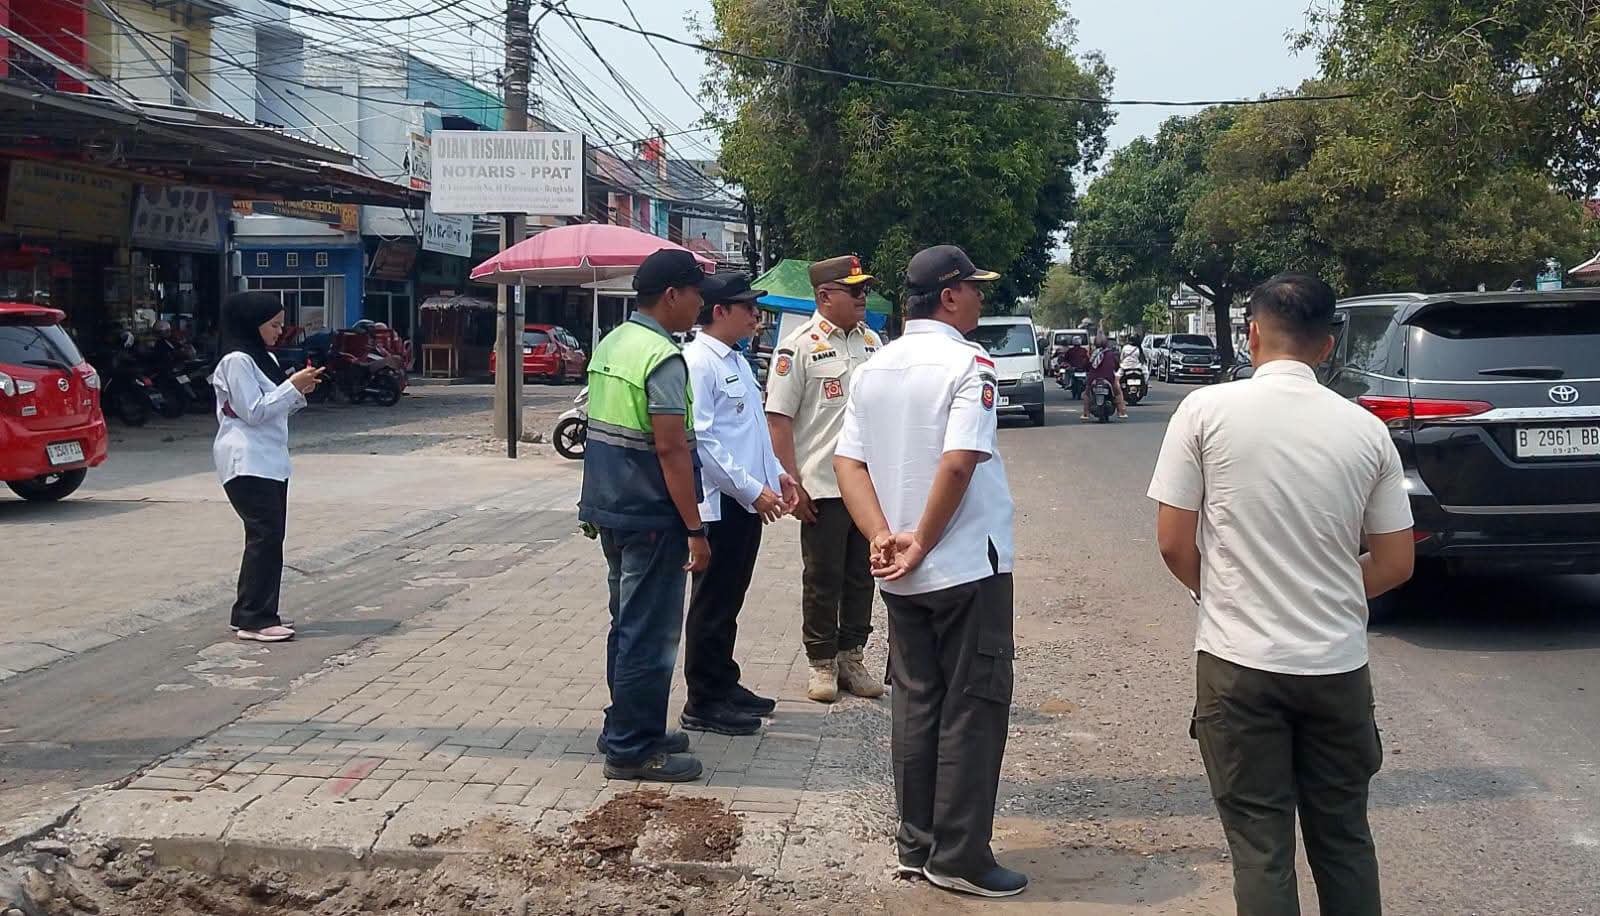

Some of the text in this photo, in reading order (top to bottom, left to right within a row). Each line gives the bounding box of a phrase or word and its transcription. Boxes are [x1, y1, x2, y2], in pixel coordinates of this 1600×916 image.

[551, 139, 576, 161] S.H.
[442, 165, 516, 178] NOTARIS
[531, 167, 572, 179] PPAT
[1519, 430, 1528, 447] B
[1538, 429, 1572, 447] 2961
